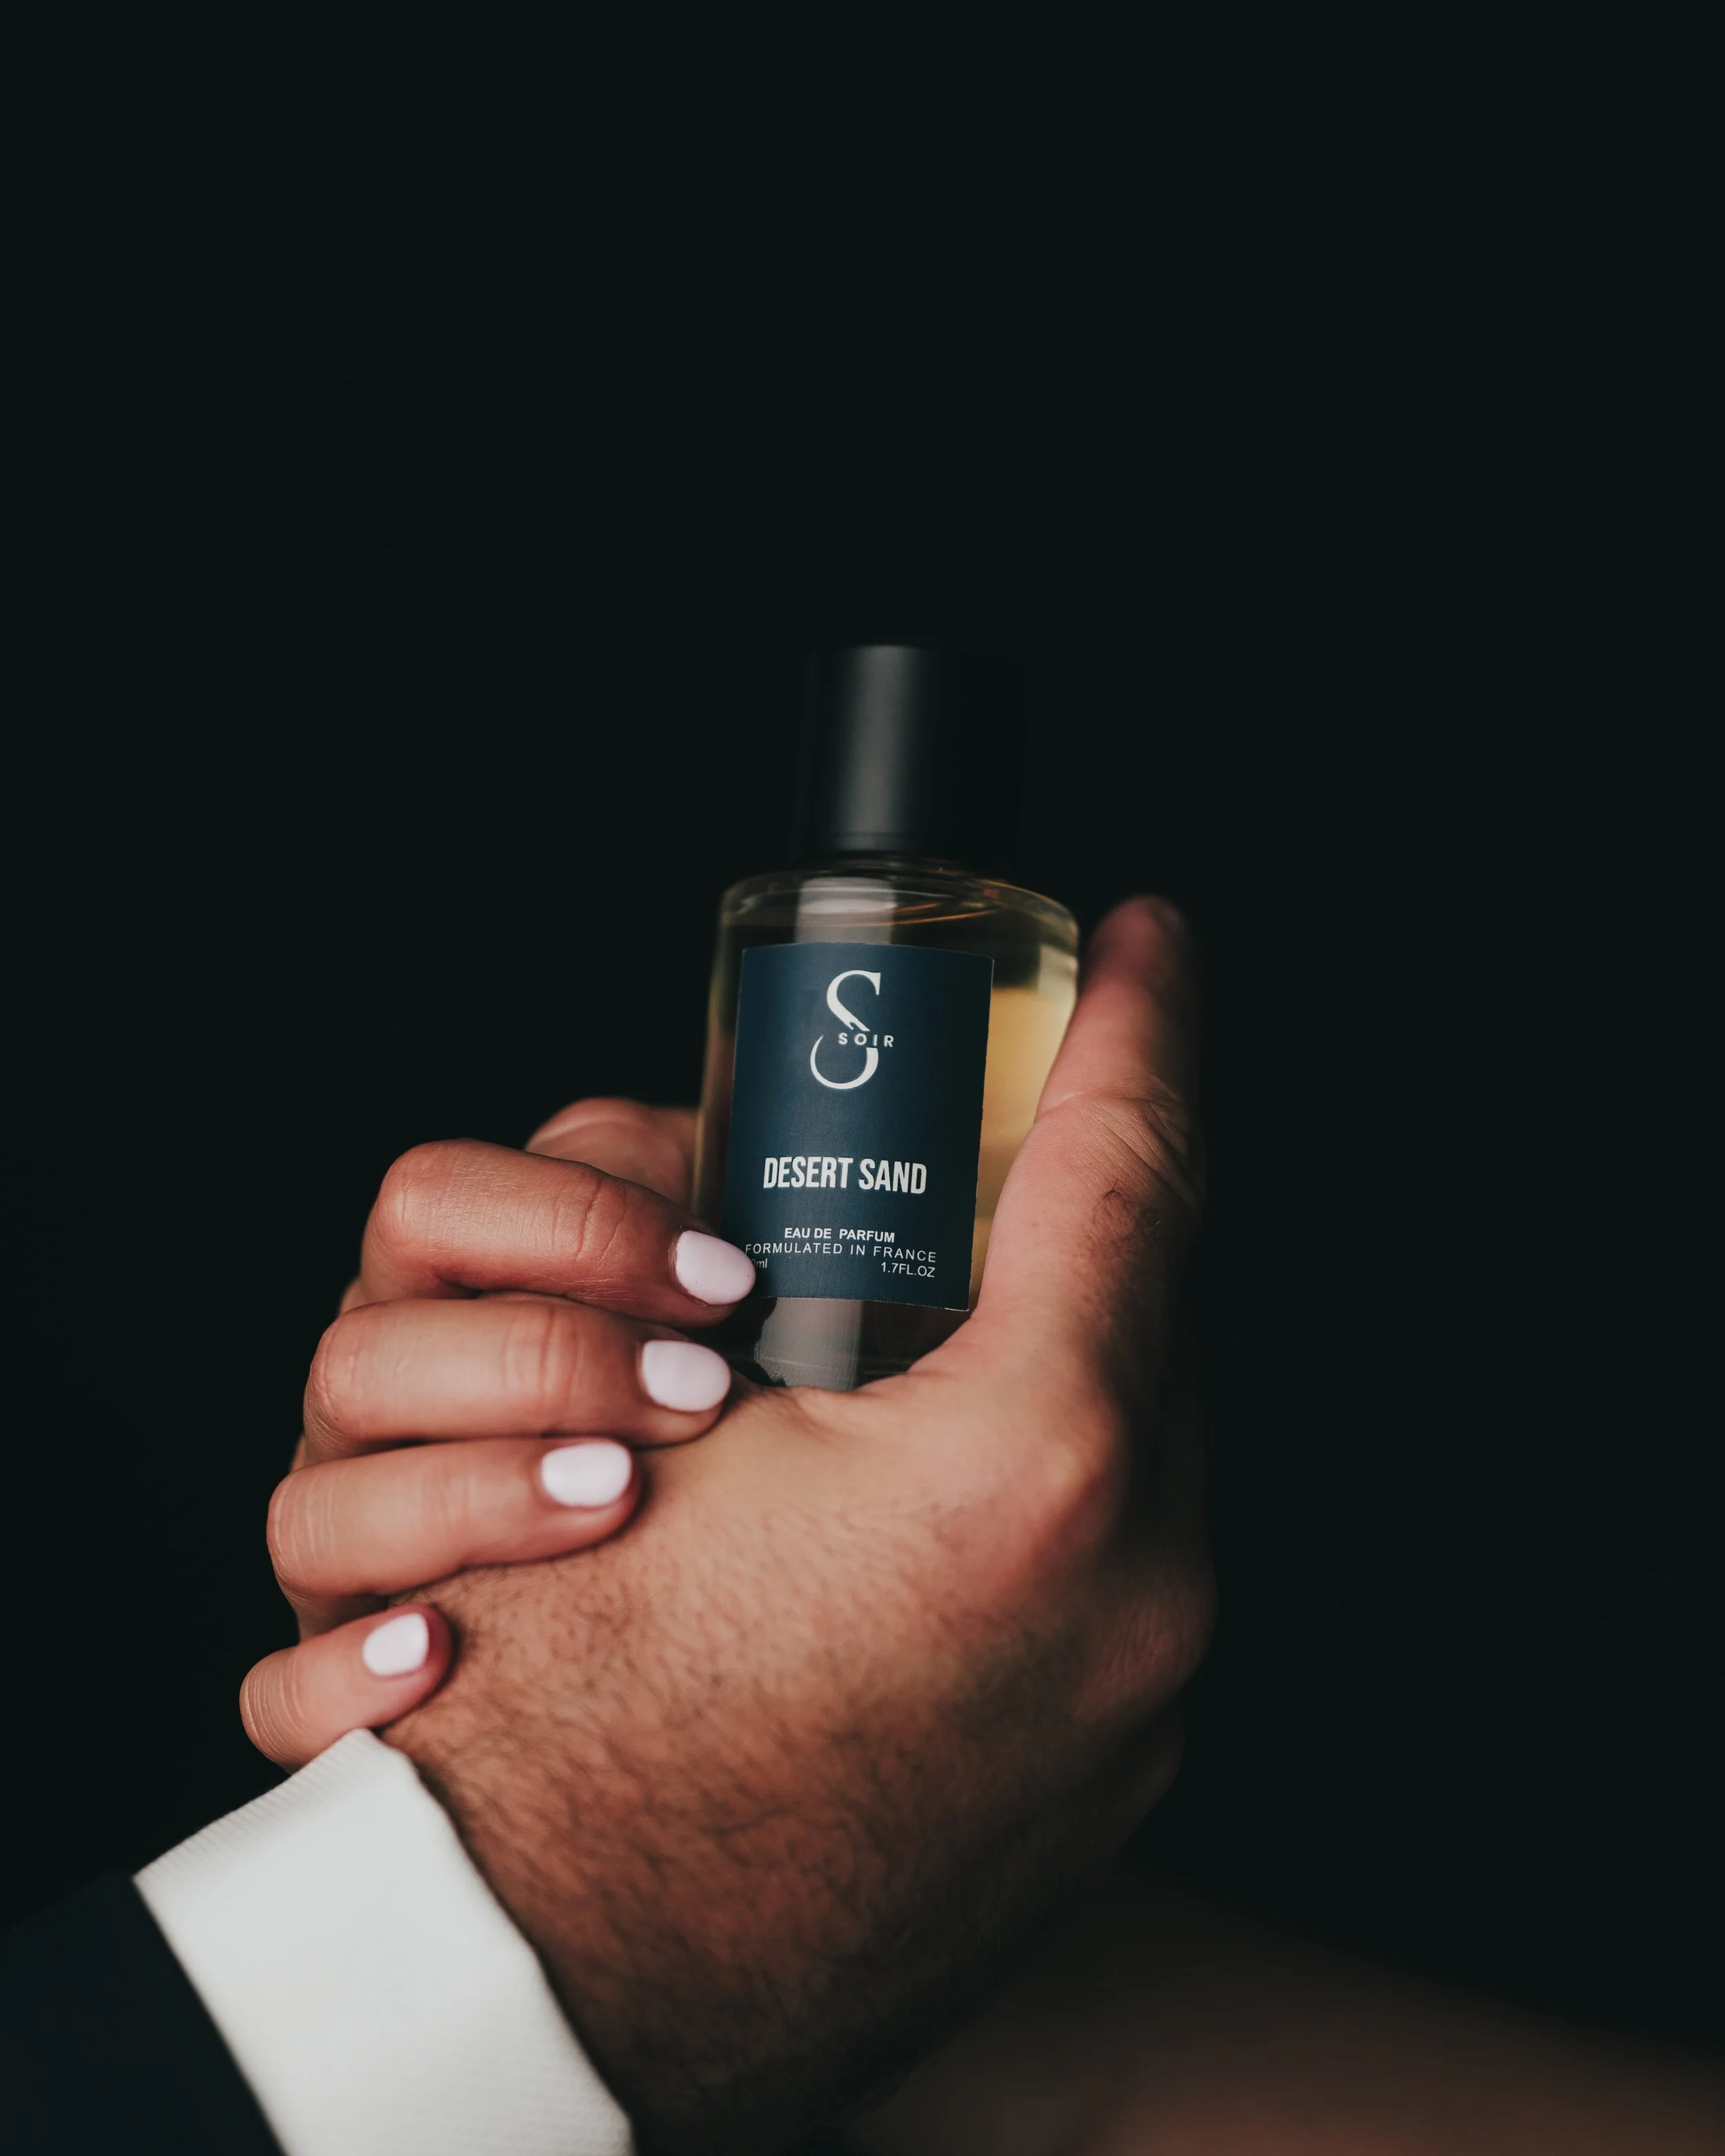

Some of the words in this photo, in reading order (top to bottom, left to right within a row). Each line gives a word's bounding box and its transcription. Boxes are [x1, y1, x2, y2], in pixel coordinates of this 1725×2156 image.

[838, 1032, 894, 1047] SOIR
[763, 1156, 854, 1189] DESERT
[858, 1158, 927, 1194] SAND
[784, 1227, 810, 1239] EAU
[814, 1227, 831, 1239] DE
[839, 1229, 896, 1243] PARFUM
[745, 1243, 843, 1255] FORMULATED
[850, 1244, 865, 1256] IN
[873, 1245, 937, 1263] FRANCE
[881, 1261, 936, 1278] 1.7FL.OZ
